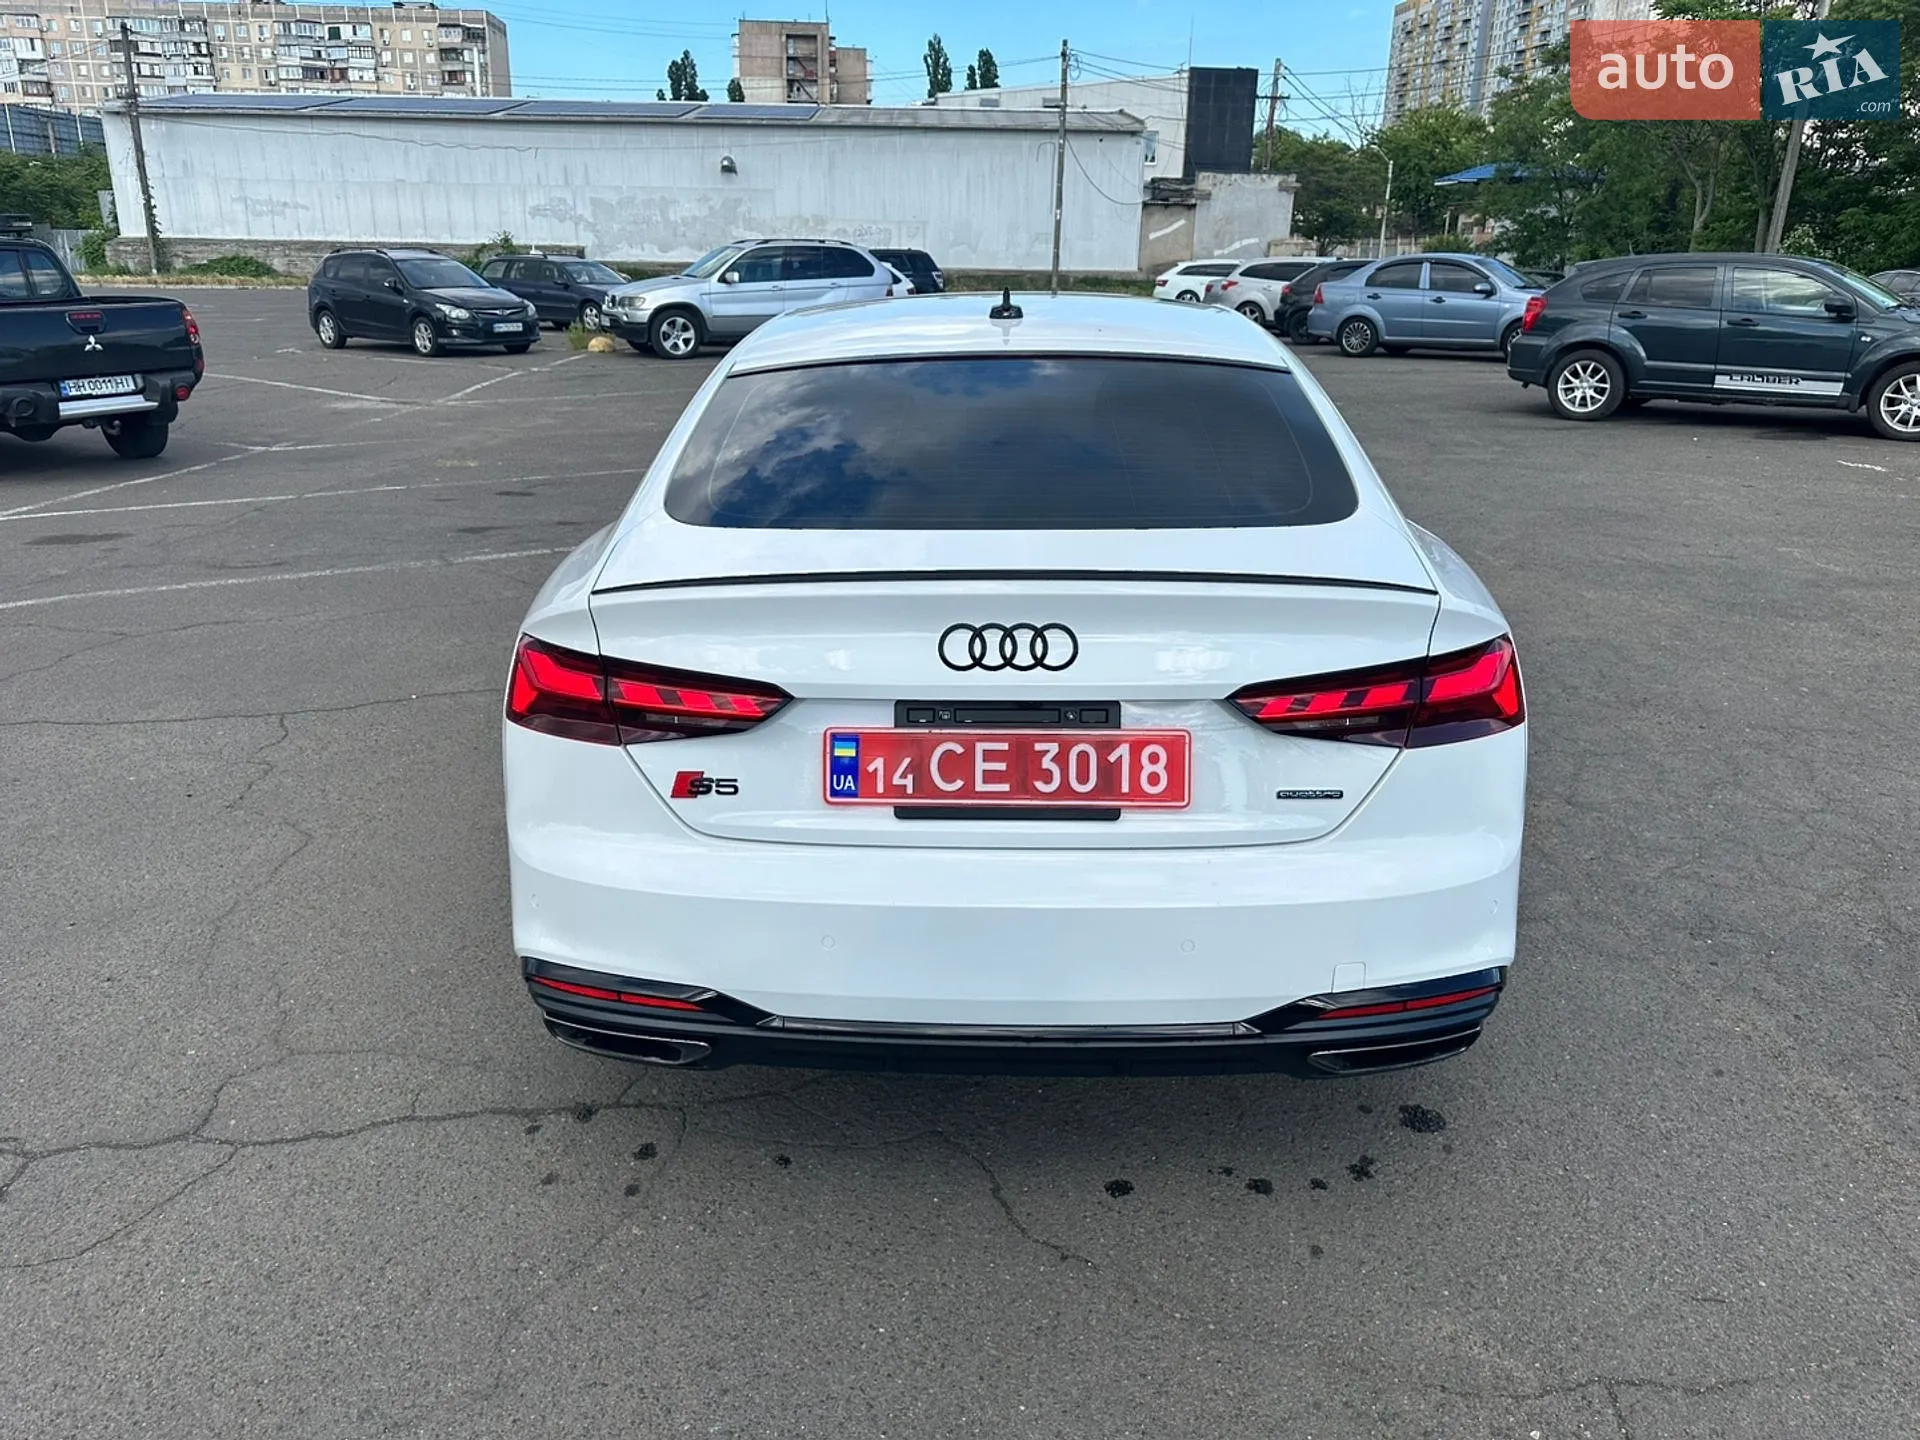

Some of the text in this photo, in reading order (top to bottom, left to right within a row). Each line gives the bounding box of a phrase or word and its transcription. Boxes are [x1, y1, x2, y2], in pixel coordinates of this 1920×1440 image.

[87, 379, 115, 391] 0011
[866, 741, 1169, 794] 14 CE 3018
[687, 777, 739, 795] S5
[832, 774, 856, 790] UA
[1279, 790, 1341, 798] quattro
